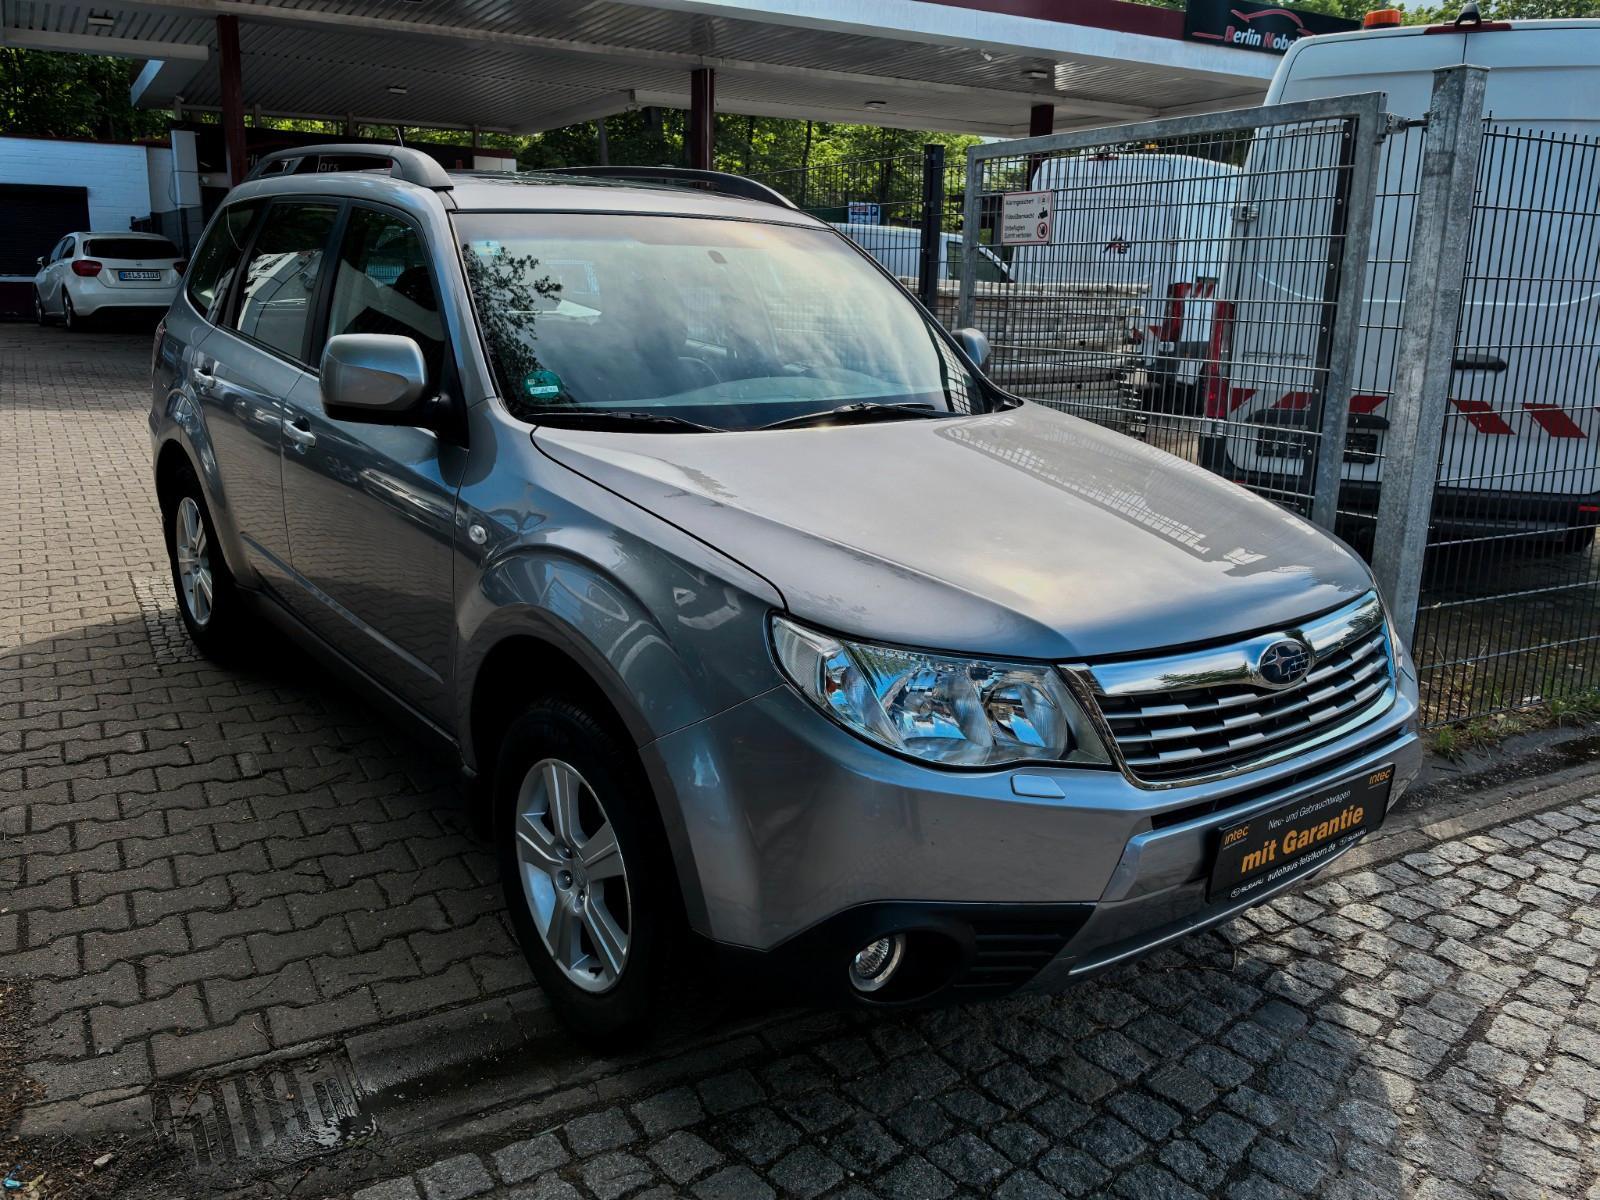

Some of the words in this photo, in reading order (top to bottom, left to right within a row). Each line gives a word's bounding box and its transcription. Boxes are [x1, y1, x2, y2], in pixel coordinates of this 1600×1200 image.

[1224, 25, 1261, 46] Berlin
[1263, 32, 1299, 50] Nobe
[1368, 769, 1392, 785] intec
[1268, 818, 1285, 831] Neu-
[1286, 809, 1299, 823] und
[1299, 790, 1351, 816] Gebrauchtwagen
[1224, 826, 1250, 845] intec
[1241, 839, 1277, 873] mit
[1282, 804, 1364, 855] Garantie
